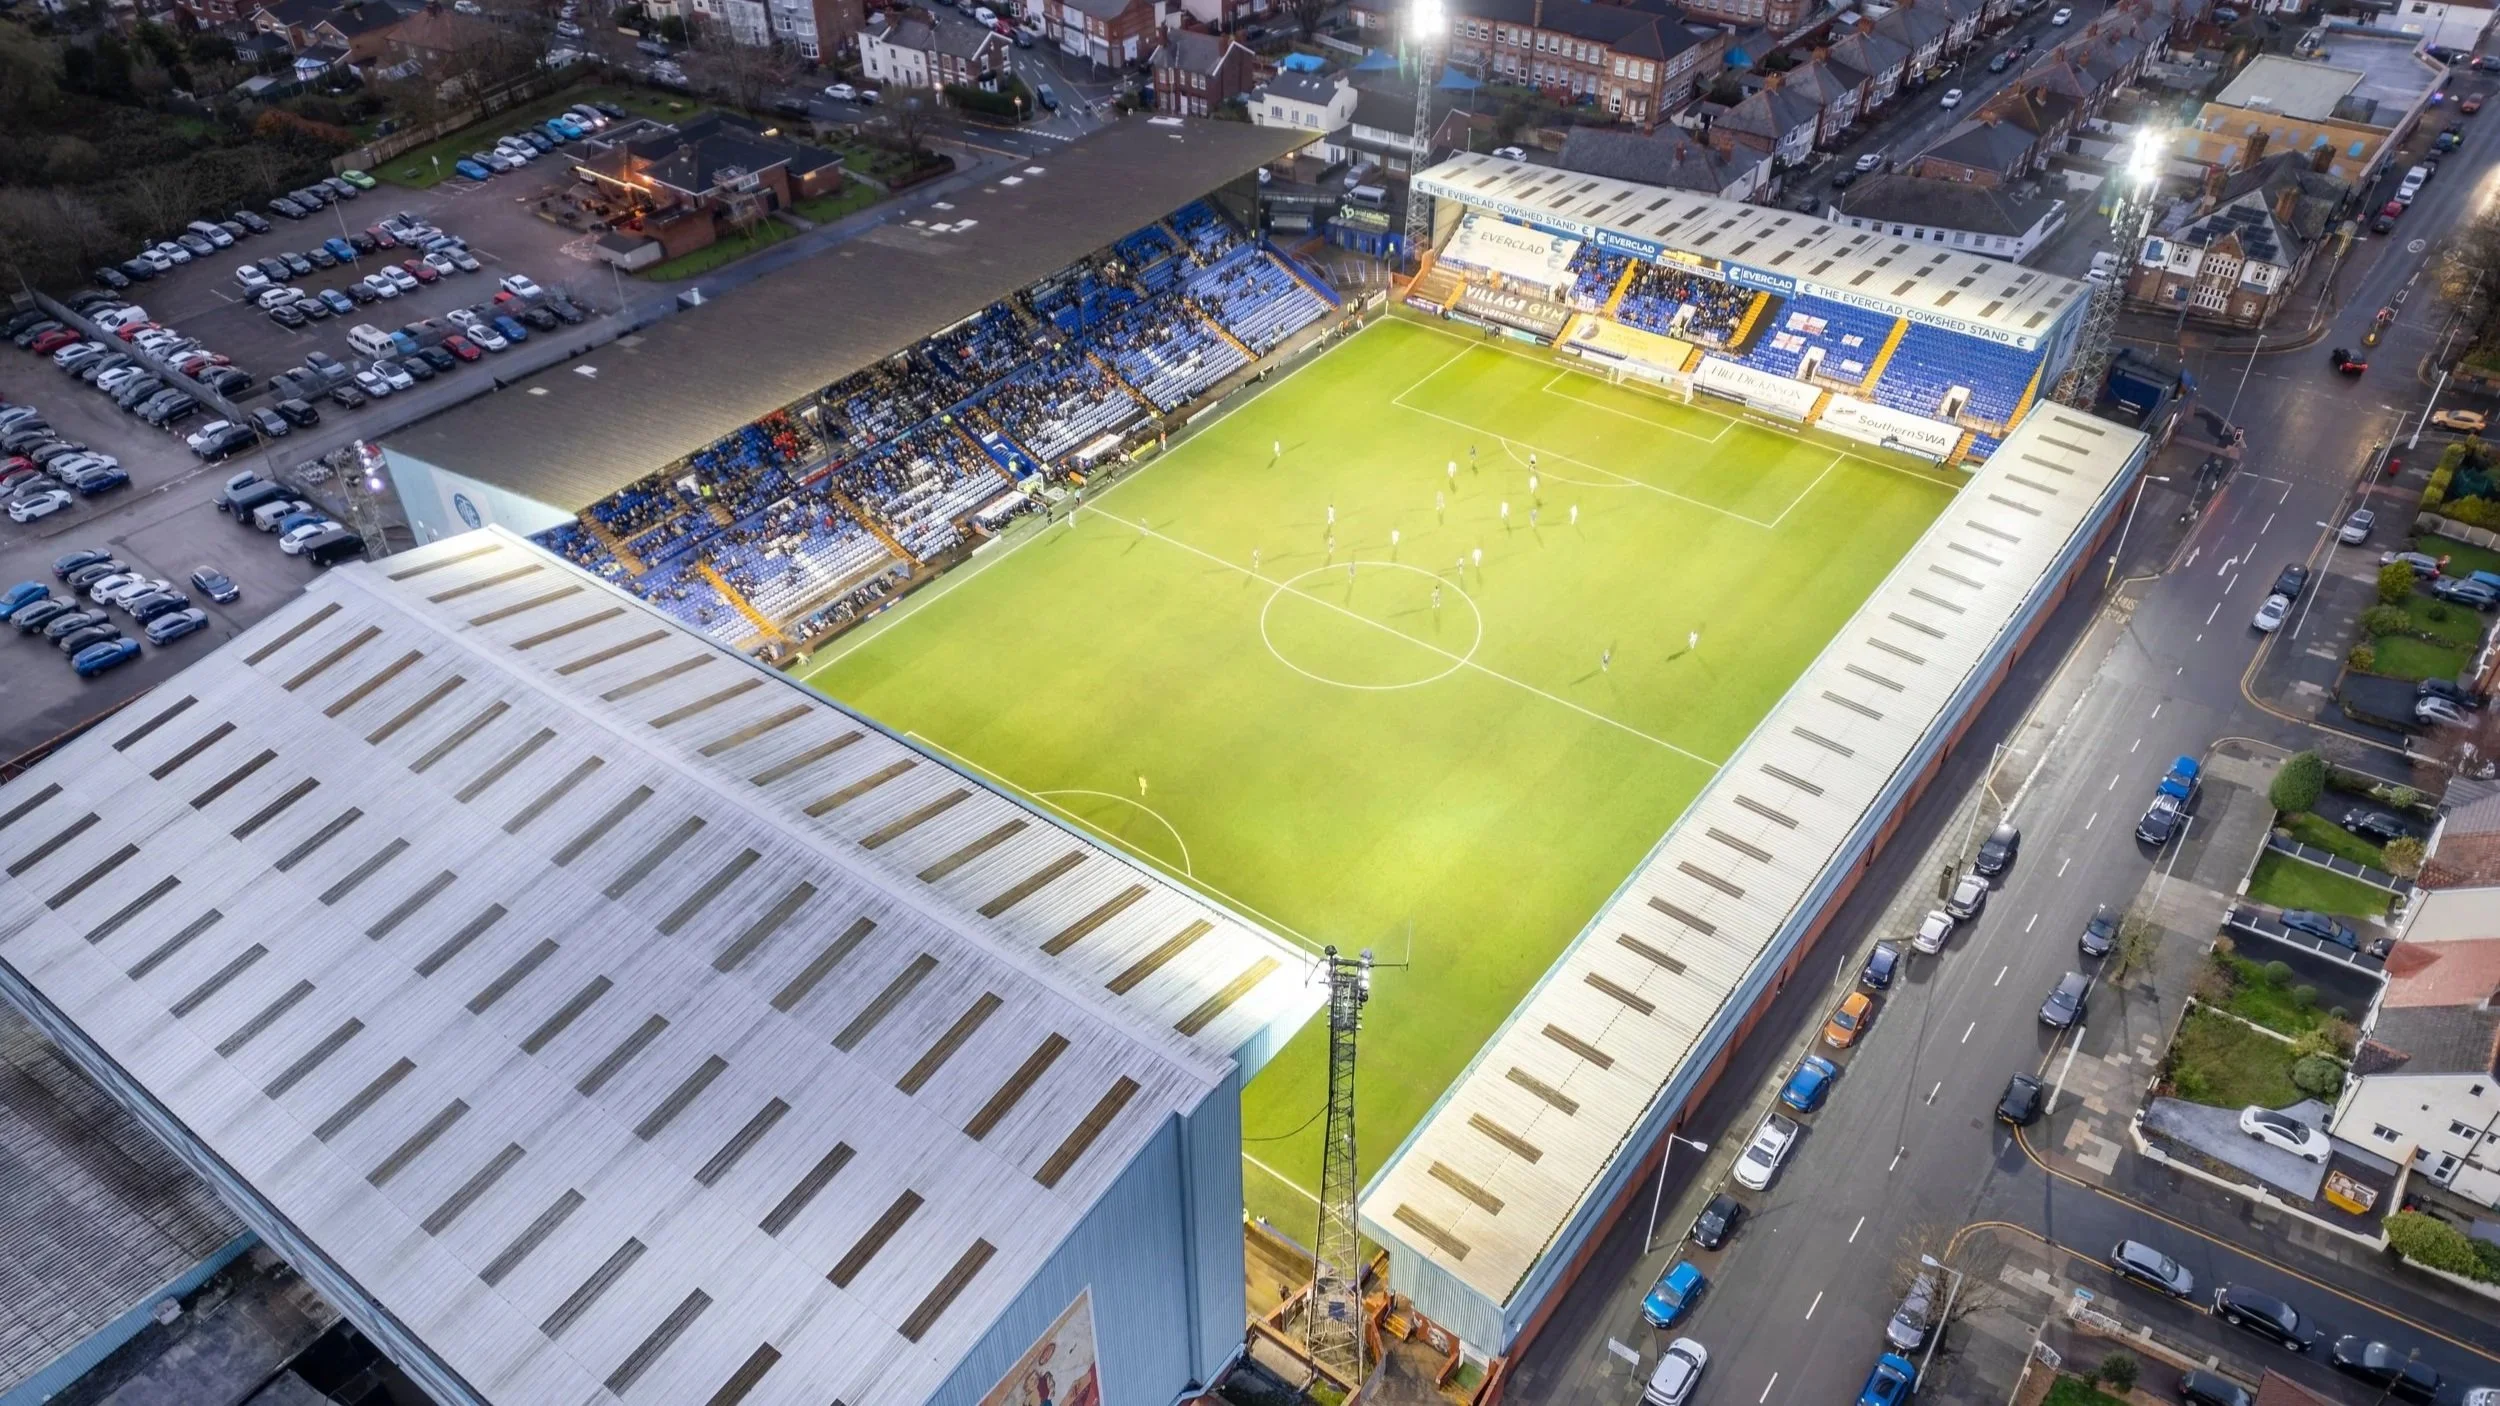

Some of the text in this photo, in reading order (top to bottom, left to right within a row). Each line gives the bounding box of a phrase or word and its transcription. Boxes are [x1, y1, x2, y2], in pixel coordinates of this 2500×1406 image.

[1428, 184, 1577, 232] THE EVERCLAD COWSHED STAND
[1480, 231, 1545, 255] EVERCLAD
[1609, 234, 1655, 254] EVERCLAD
[1742, 270, 1793, 290] EVERCLAD
[1465, 285, 1566, 322] VILLAGE GYM
[1467, 303, 1546, 330] VILLAGEGYM.CO.UK
[1819, 286, 2009, 342] THE EVERCLAD COWSHED STAND
[1858, 415, 1946, 447] SouthernSWA
